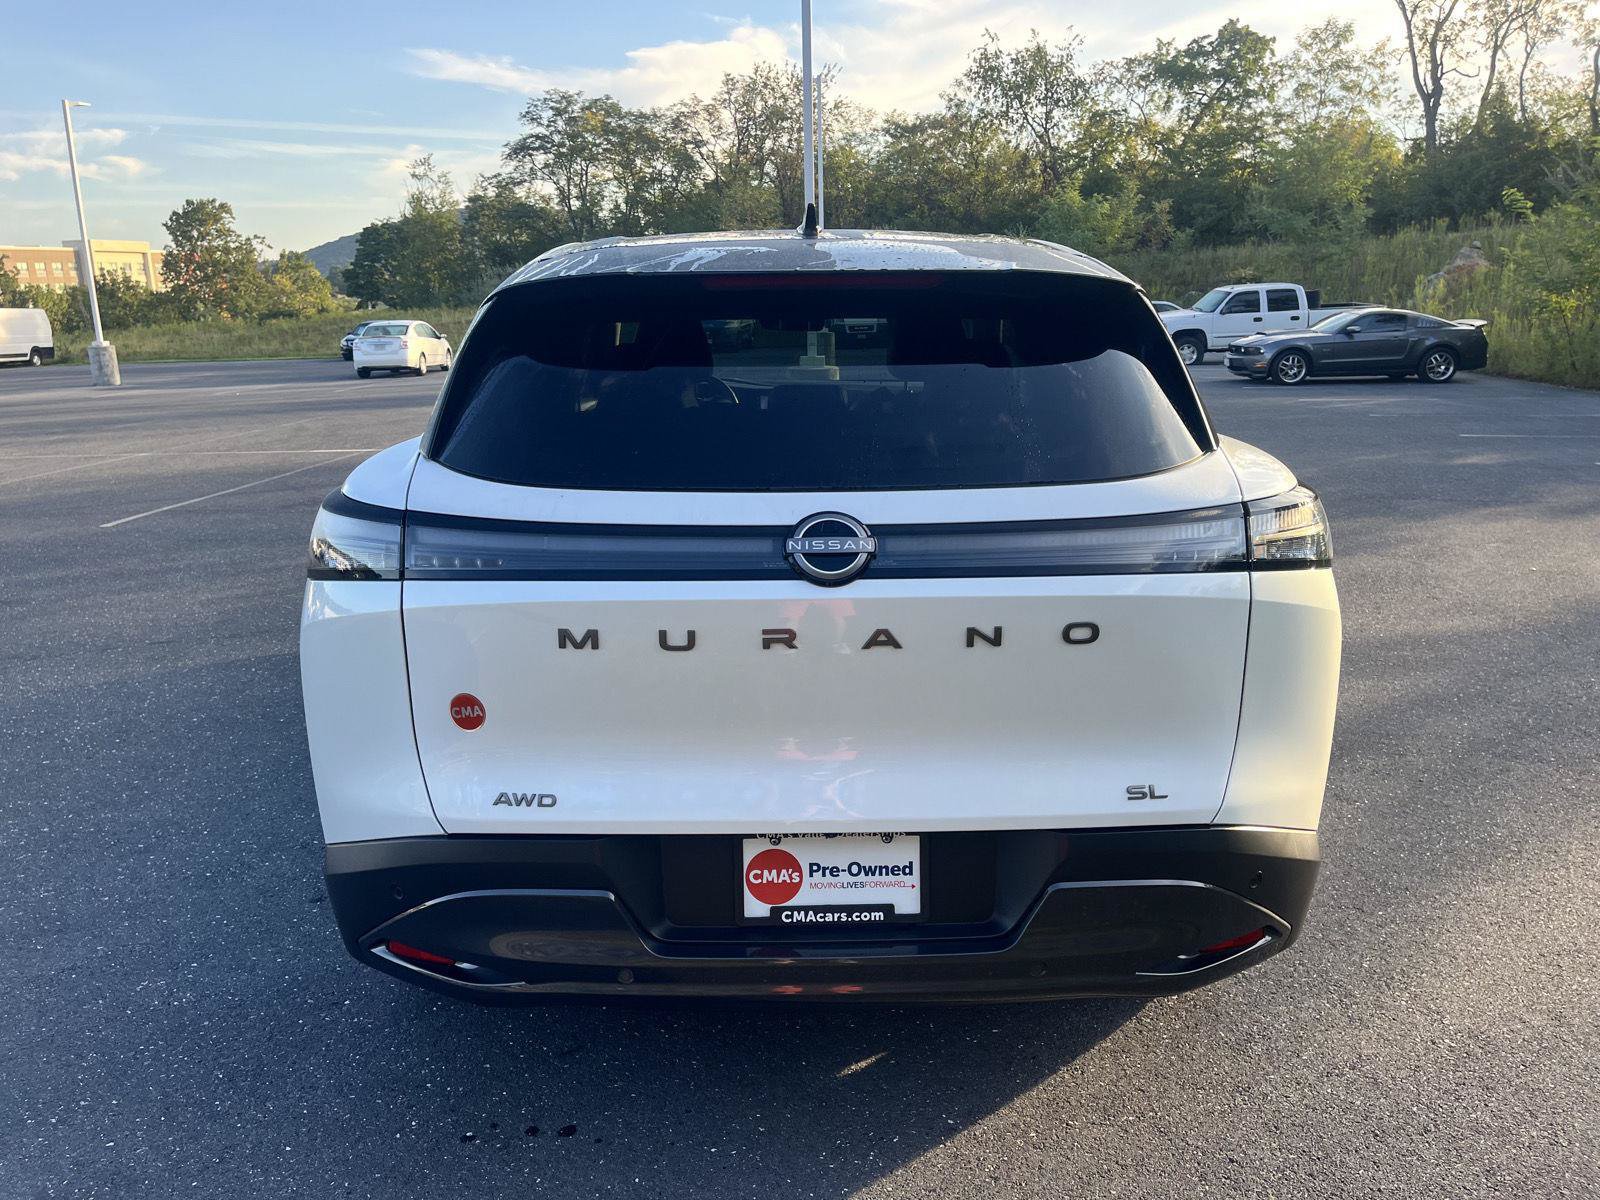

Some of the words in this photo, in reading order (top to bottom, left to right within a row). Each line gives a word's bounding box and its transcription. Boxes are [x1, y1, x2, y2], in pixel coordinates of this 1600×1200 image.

[788, 540, 872, 550] NISSAN
[557, 621, 1101, 651] MURANO
[451, 705, 483, 719] CMA
[492, 791, 558, 808] AWD
[1126, 784, 1169, 801] SL
[749, 868, 801, 884] CMA's
[808, 861, 914, 878] Pre-Owned
[781, 910, 884, 923] CMAcars.com
